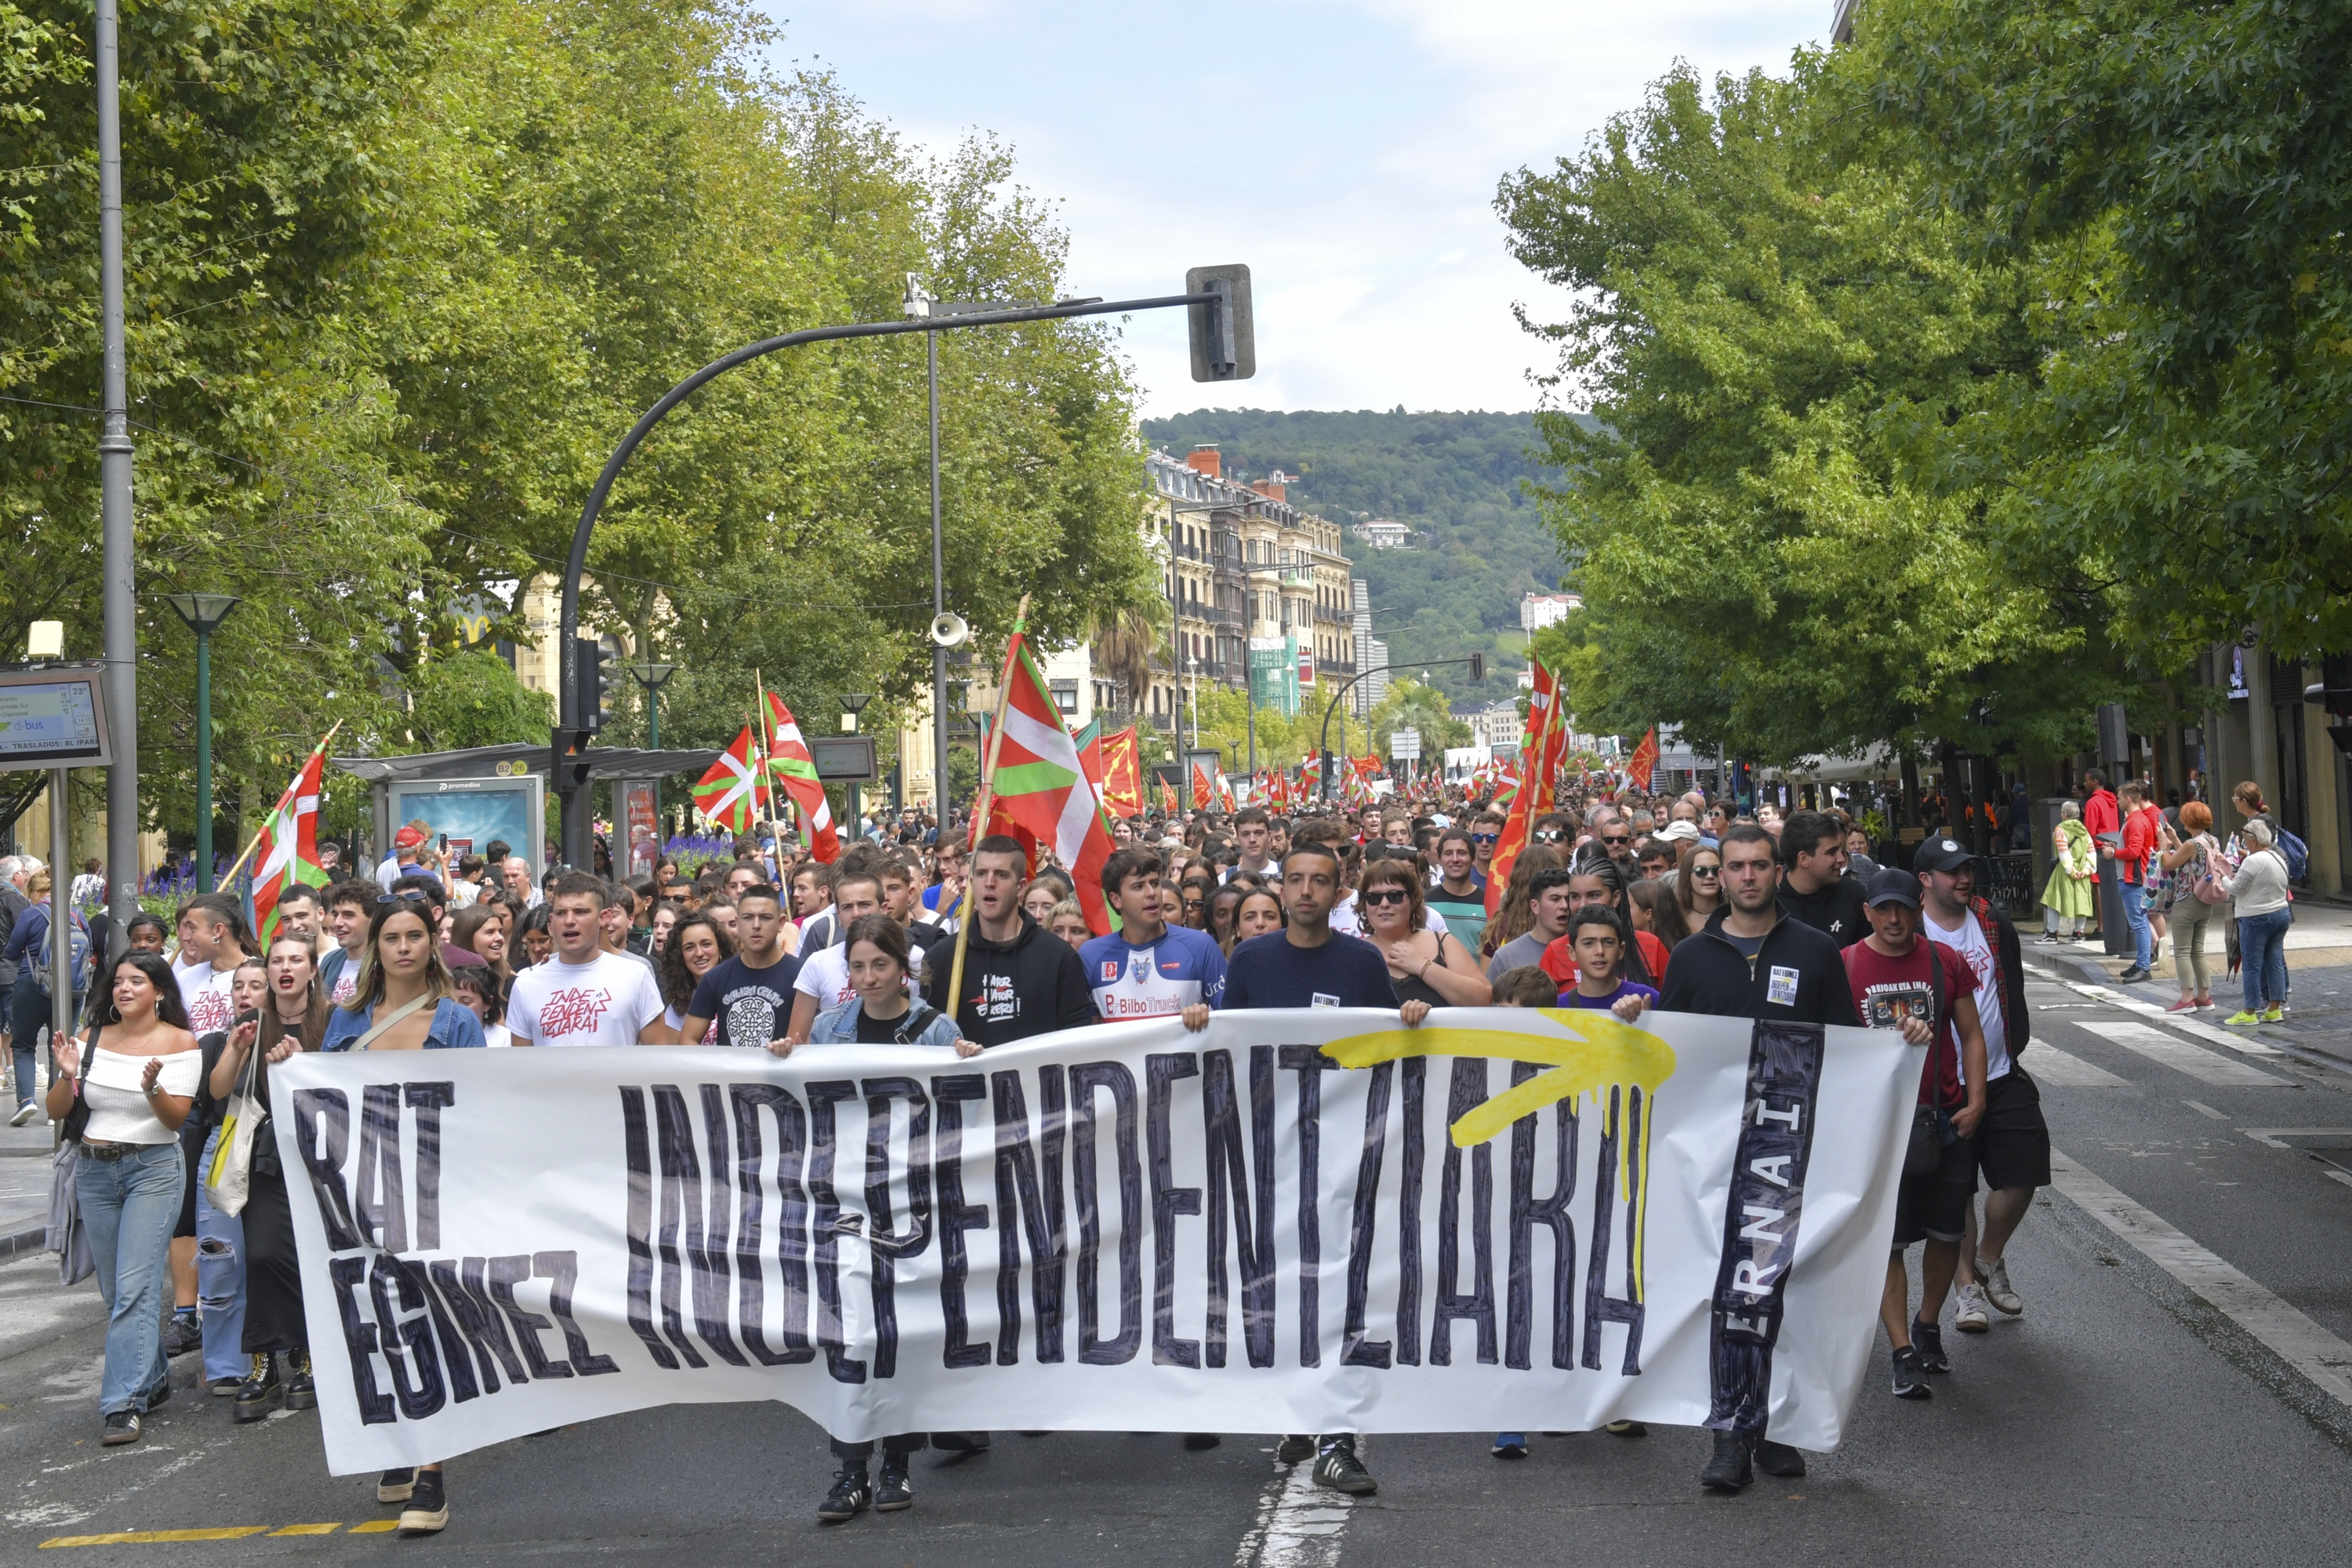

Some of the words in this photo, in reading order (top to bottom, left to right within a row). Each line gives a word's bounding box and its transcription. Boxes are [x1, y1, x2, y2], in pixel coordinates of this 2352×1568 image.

[13, 741, 63, 750] TRASLADOS:
[498, 764, 510, 773] B2
[514, 763, 524, 771] 26
[194, 990, 232, 1005] INDE
[545, 987, 595, 1006] INDE
[1314, 995, 1323, 1004] BAT
[539, 1002, 597, 1023] PENDEN
[293, 1081, 455, 1253] BAT
[618, 1044, 1653, 1385] INDEPENDENTZIARA
[1726, 1102, 1802, 1338] ERNAI
